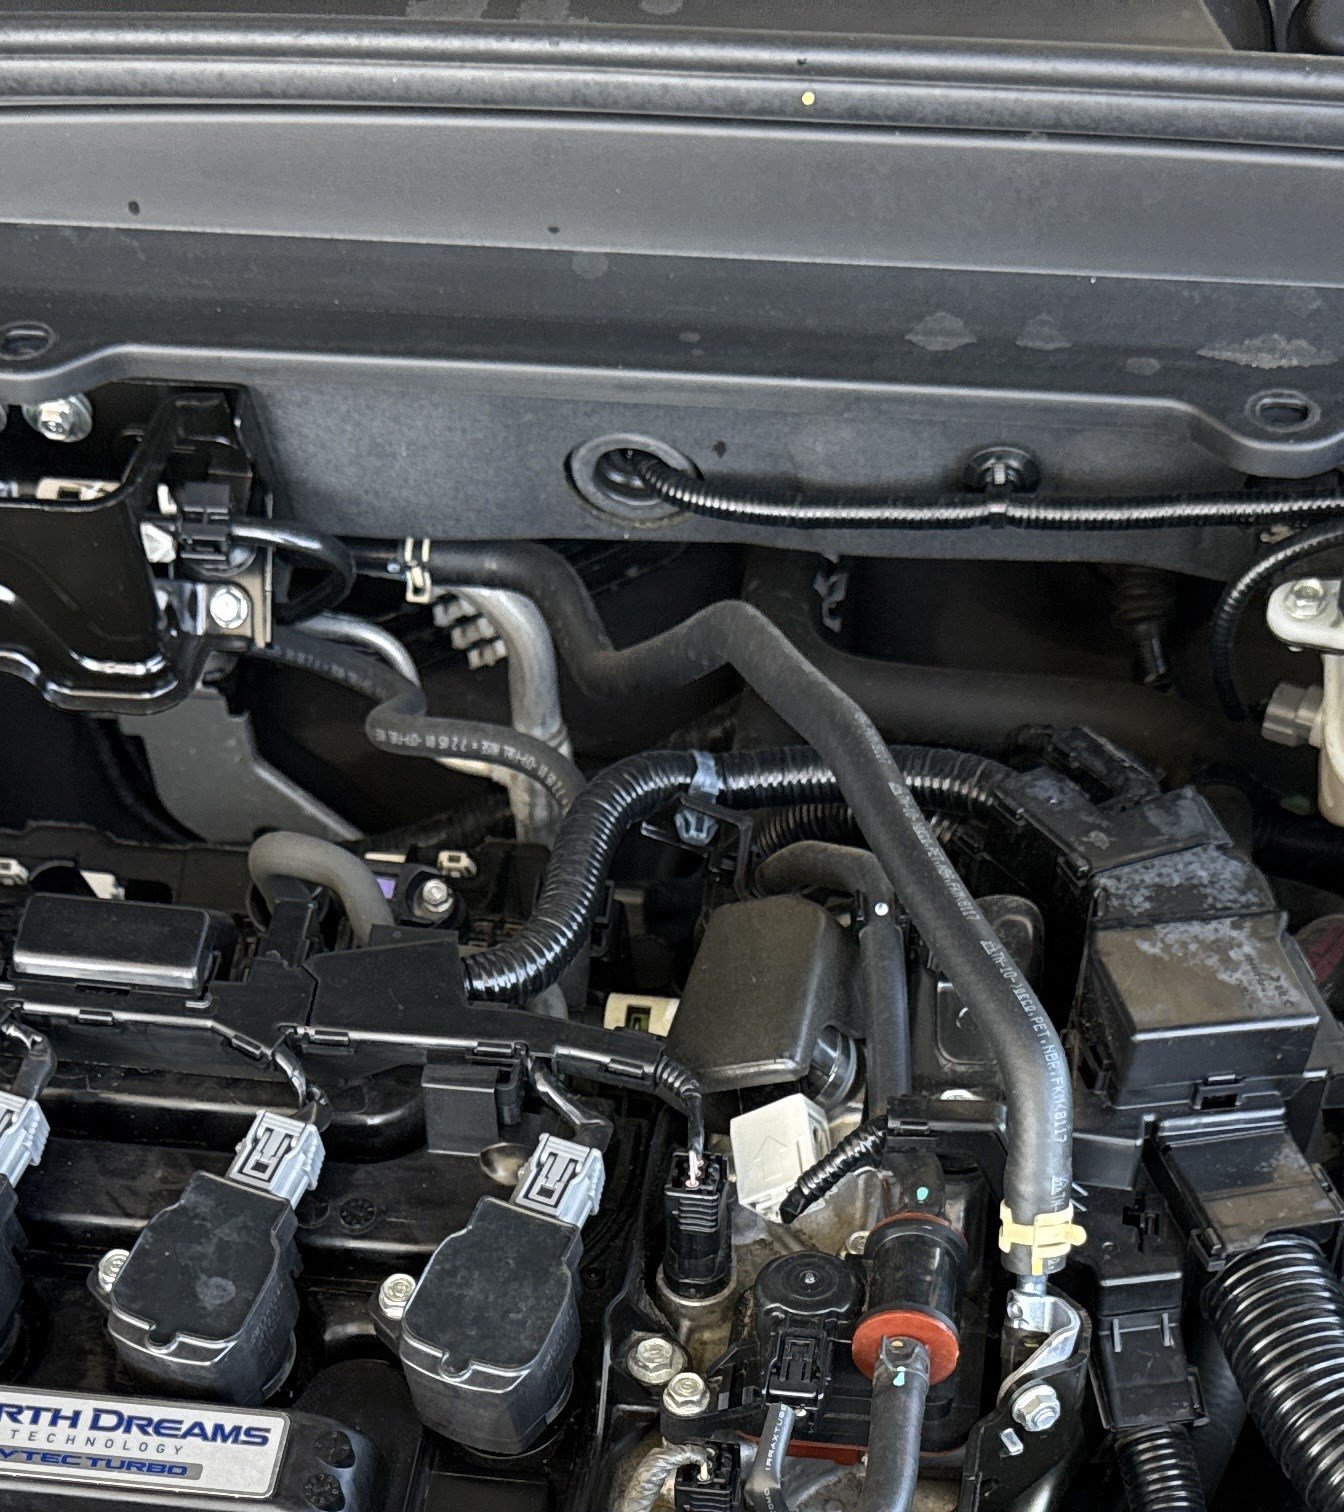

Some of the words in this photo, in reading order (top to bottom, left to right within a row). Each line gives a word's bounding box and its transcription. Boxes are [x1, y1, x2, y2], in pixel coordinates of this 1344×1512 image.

[88, 1407, 272, 1447] DREAMS
[10, 1428, 184, 1456] TECHNOLOGY
[83, 1456, 188, 1476] TURBO
